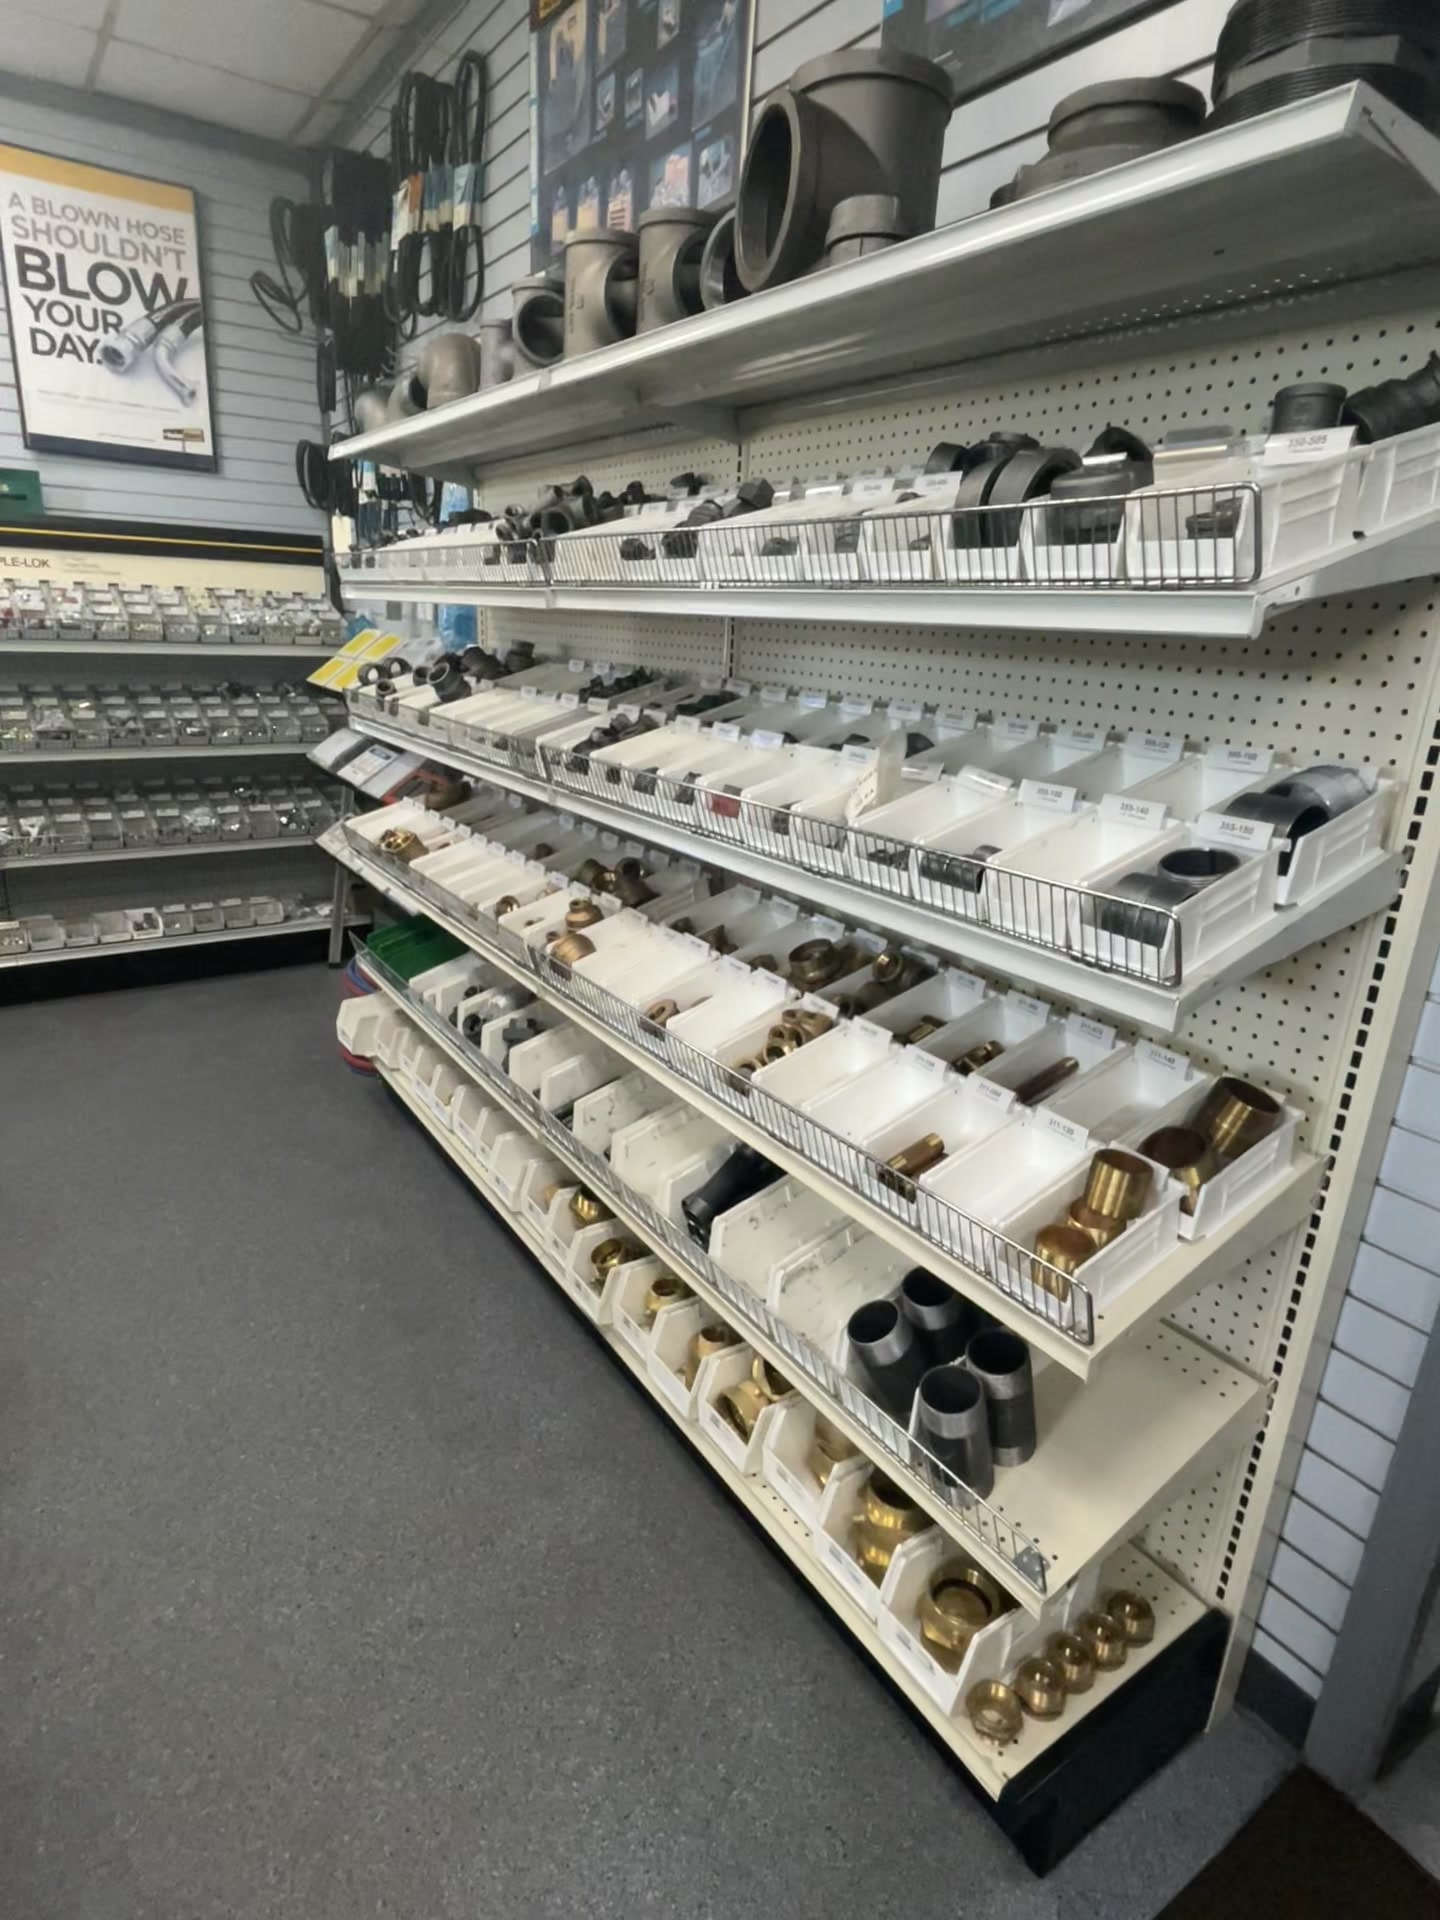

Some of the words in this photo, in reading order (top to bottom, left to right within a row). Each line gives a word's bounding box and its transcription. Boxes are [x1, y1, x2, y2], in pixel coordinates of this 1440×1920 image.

[8, 192, 25, 212] A
[32, 196, 120, 231] BLOWN
[126, 218, 186, 246] HOSE
[11, 215, 186, 272] SHOULDN'T
[14, 244, 189, 313] BLOW
[21, 294, 124, 335] YOUR
[29, 326, 103, 366] DAY.
